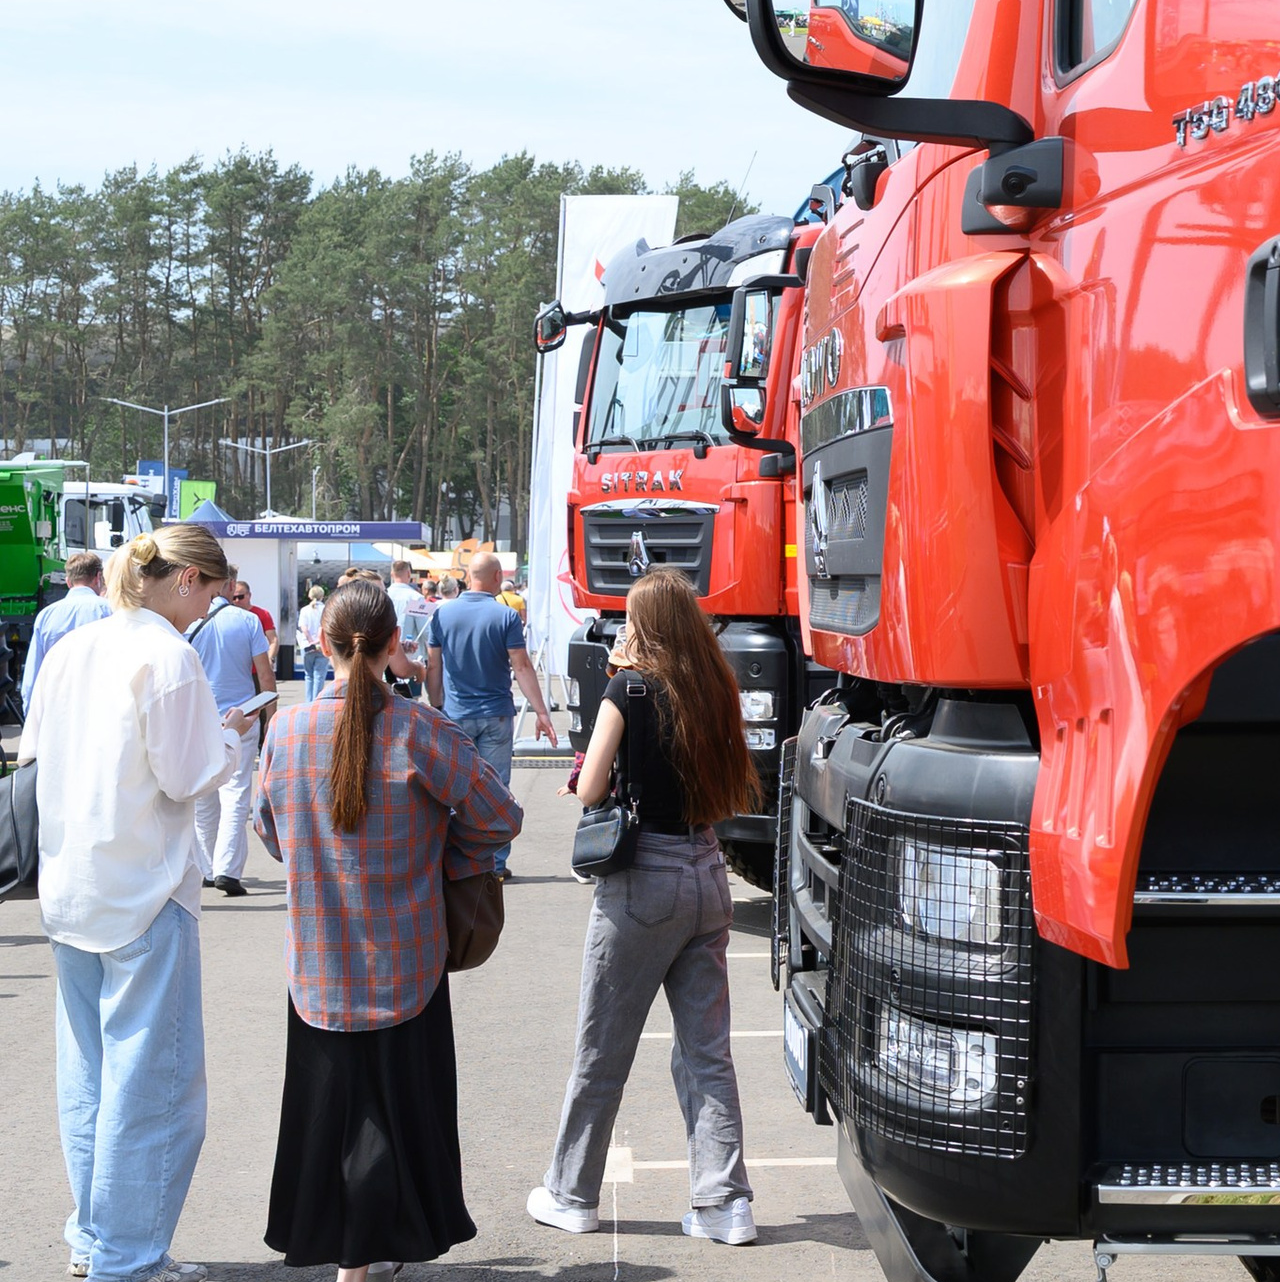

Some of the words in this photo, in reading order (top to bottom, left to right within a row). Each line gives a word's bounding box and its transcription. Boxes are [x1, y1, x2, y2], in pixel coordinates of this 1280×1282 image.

[1172, 95, 1229, 148] T5G
[601, 468, 685, 494] SITRAK
[254, 523, 361, 535] БЕЛТЕХАВТОПРОМ
